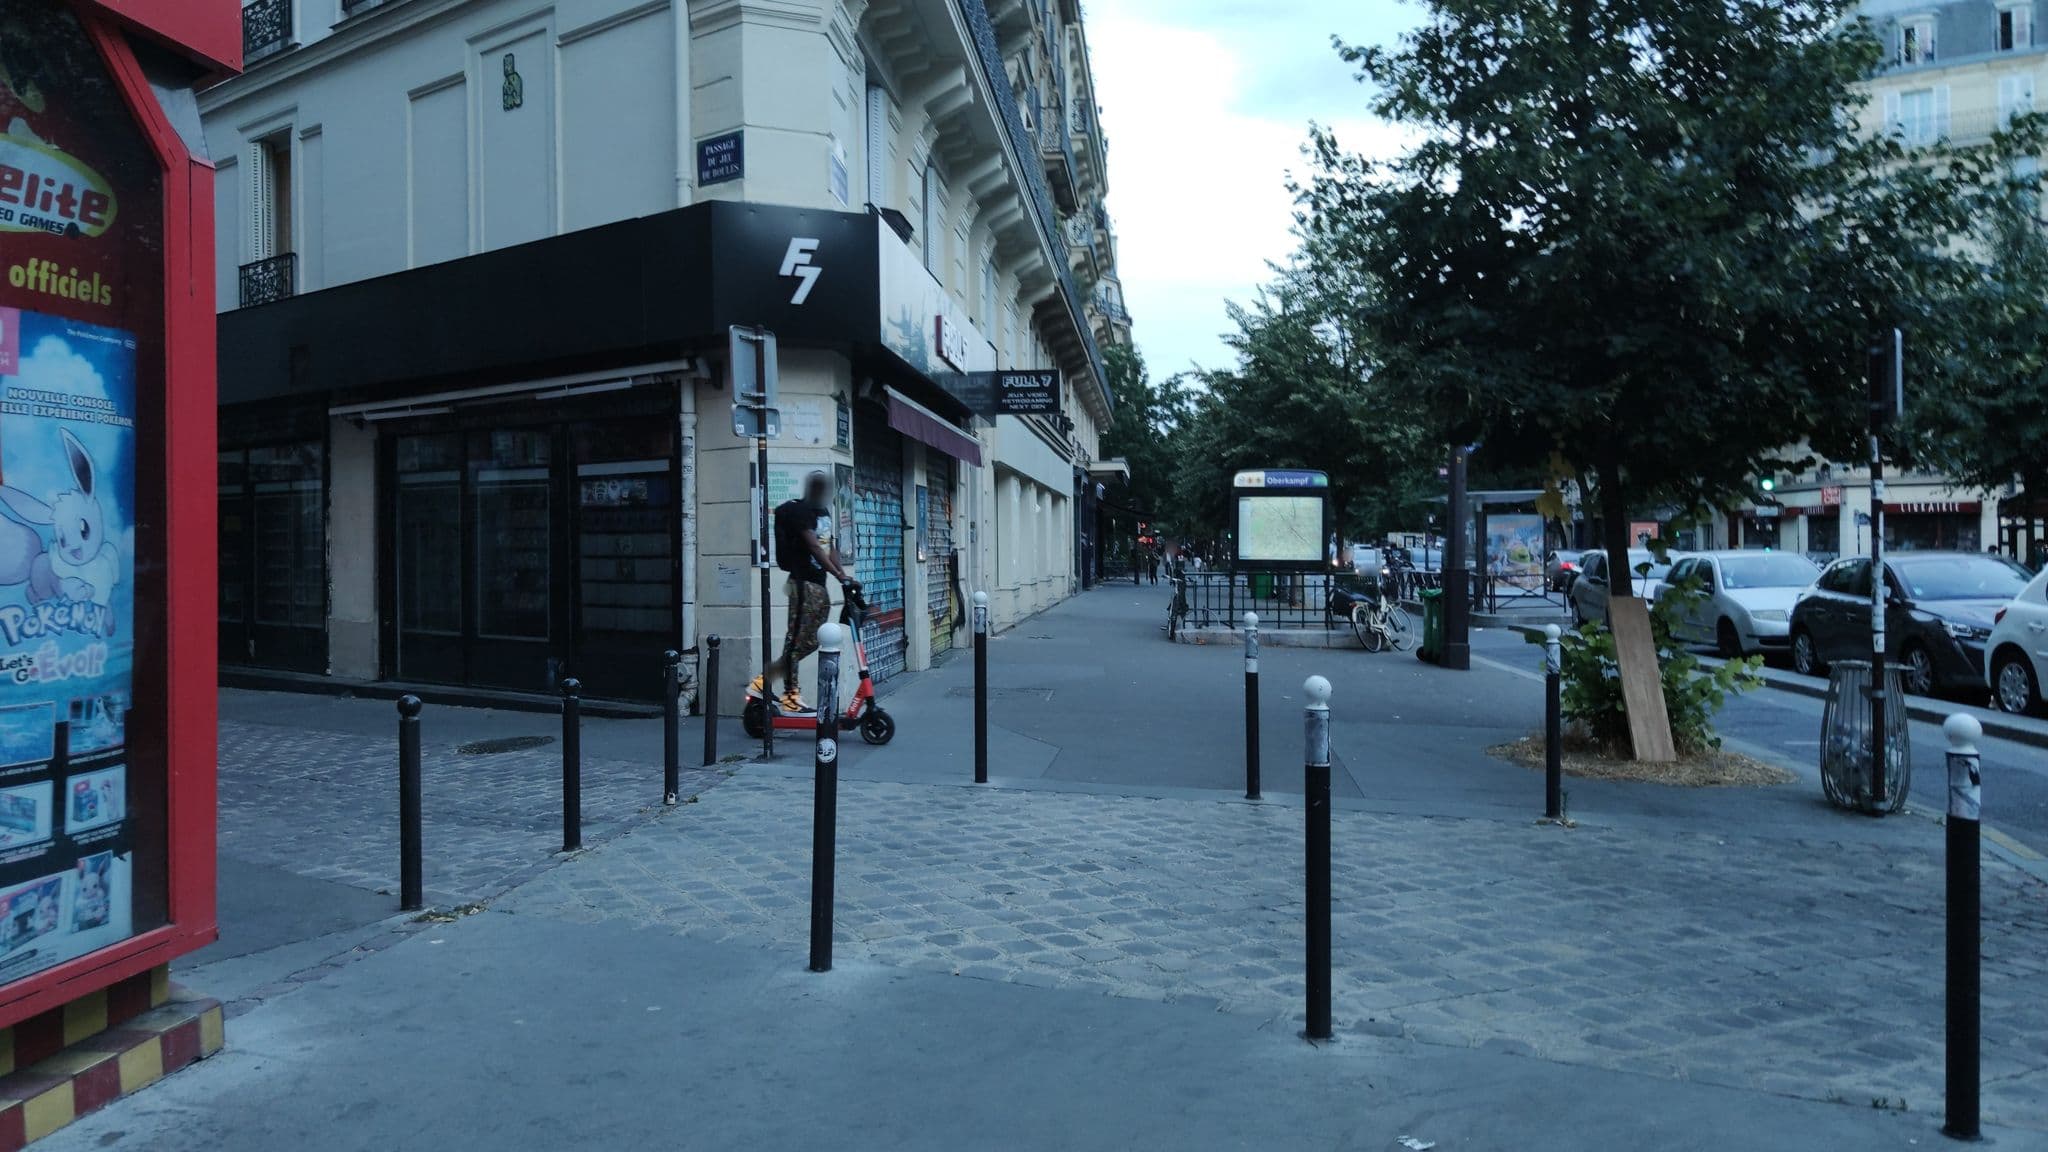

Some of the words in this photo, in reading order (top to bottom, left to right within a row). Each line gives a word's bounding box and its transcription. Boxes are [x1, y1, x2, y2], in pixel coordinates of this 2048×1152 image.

[705, 139, 736, 155] PASSAGE
[712, 163, 740, 178] BOULES
[19, 213, 65, 235] GAMES
[8, 257, 112, 306] officiels
[1002, 375, 1040, 388] FULL
[1041, 375, 1053, 388] 7
[8, 388, 68, 404] NOUVELLE
[1266, 476, 1309, 487] Oberkampf
[0, 656, 33, 671] Let's
